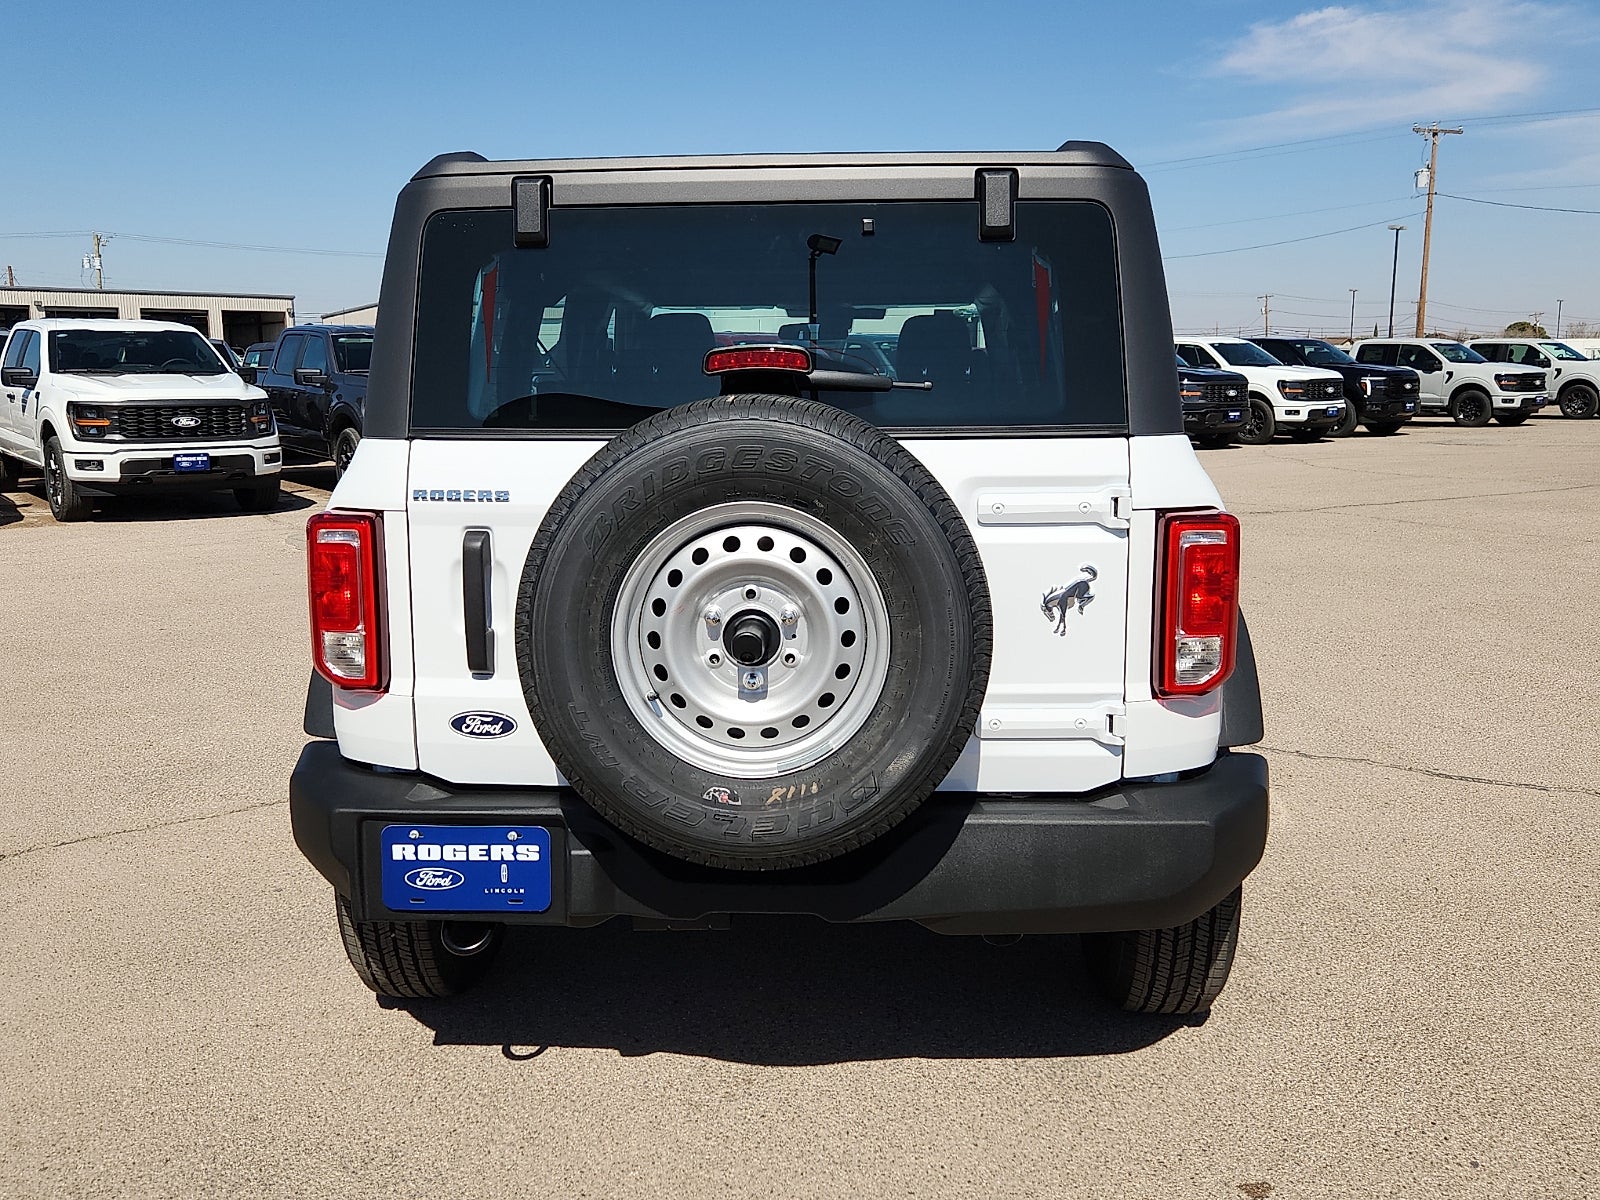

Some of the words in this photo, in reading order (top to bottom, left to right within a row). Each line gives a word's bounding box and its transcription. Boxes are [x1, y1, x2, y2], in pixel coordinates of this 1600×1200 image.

[413, 489, 510, 503] ROGERS
[583, 445, 916, 557] BRIDGESTONE
[391, 843, 540, 861] ROGERS
